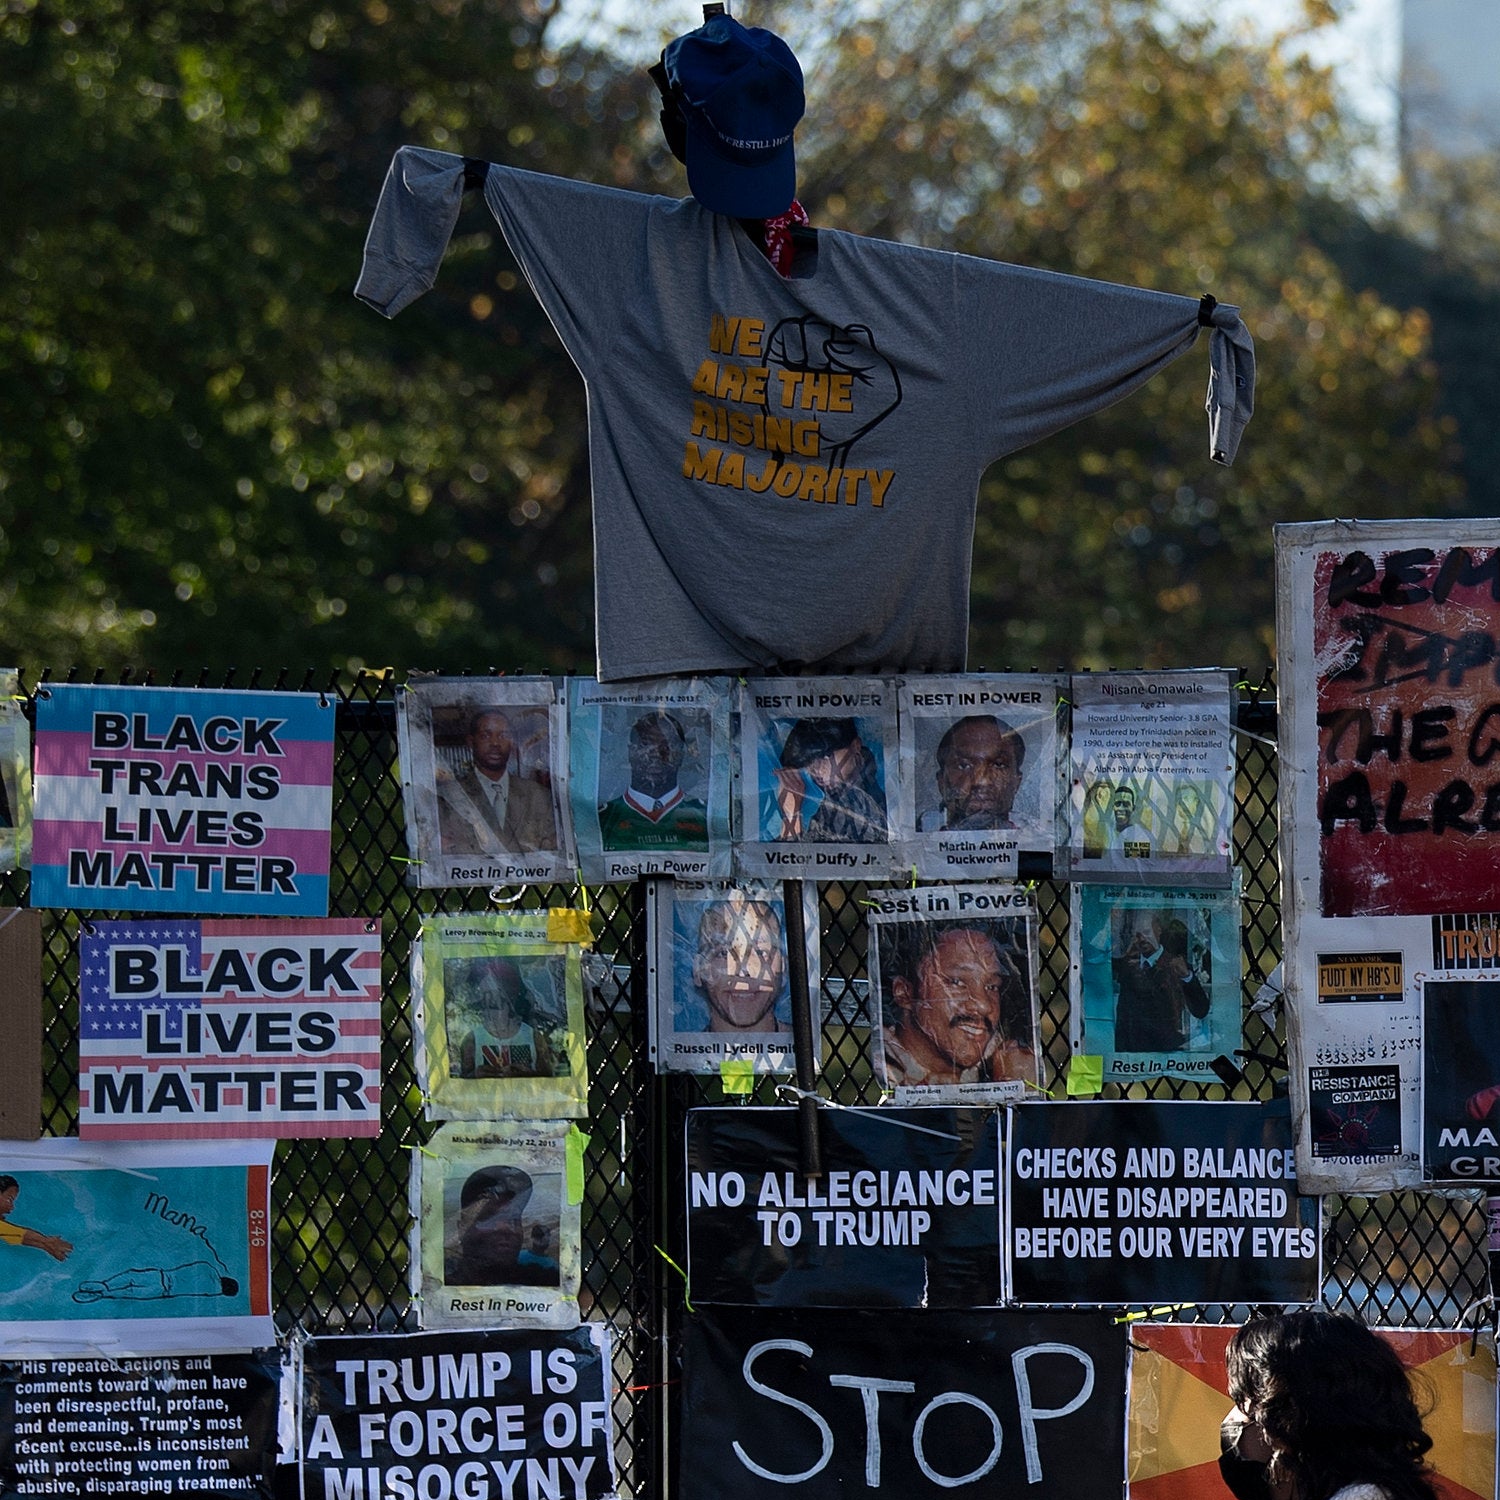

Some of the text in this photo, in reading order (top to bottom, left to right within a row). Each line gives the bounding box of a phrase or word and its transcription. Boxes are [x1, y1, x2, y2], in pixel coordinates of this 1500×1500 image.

[745, 140, 771, 149] STILL
[709, 313, 765, 357] WE
[692, 359, 854, 413] ARE THE
[690, 400, 820, 457] RISING
[682, 442, 895, 507] MAJORITY
[913, 692, 1042, 706] REST IN POWER
[90, 710, 290, 759] BLACK
[1318, 708, 1454, 765] THE
[89, 760, 281, 801] TRANS
[101, 807, 265, 848] LIVES
[939, 840, 1018, 852] Martin Anwar
[67, 851, 300, 896] MATTER
[452, 865, 552, 879] Rest In Power
[946, 853, 1011, 864] Duckworth
[692, 1169, 995, 1208] NO ALLEGIANCE
[757, 1211, 932, 1246] TO TRUMP
[336, 1348, 578, 1405] TRUMP IS
[308, 1401, 606, 1460] A FORCE OF
[732, 1339, 1095, 1488] STOP
